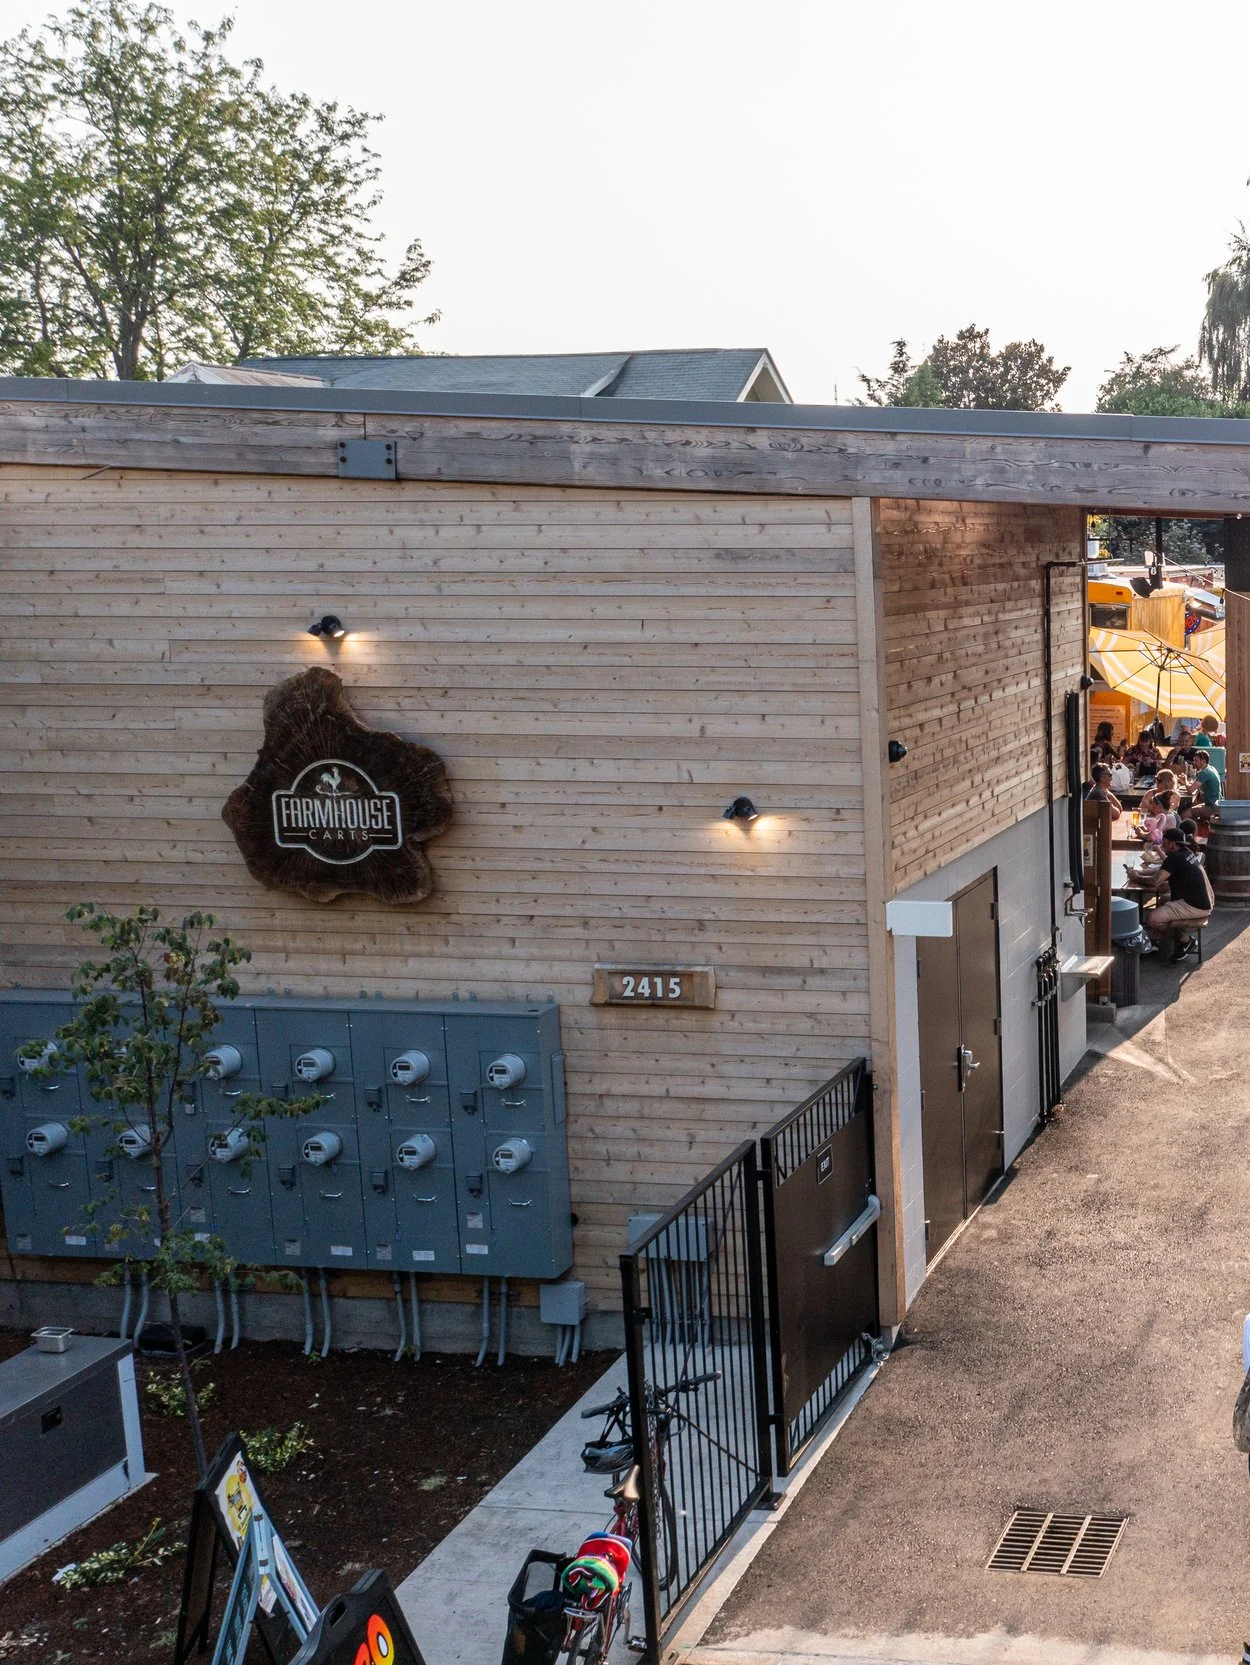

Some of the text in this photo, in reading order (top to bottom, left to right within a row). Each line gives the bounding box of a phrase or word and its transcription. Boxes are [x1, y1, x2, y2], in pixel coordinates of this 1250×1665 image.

[281, 797, 392, 829] FARMHOUSE
[308, 829, 369, 840] CARTS
[622, 976, 681, 998] 2415
[821, 1156, 830, 1172] EXIT
